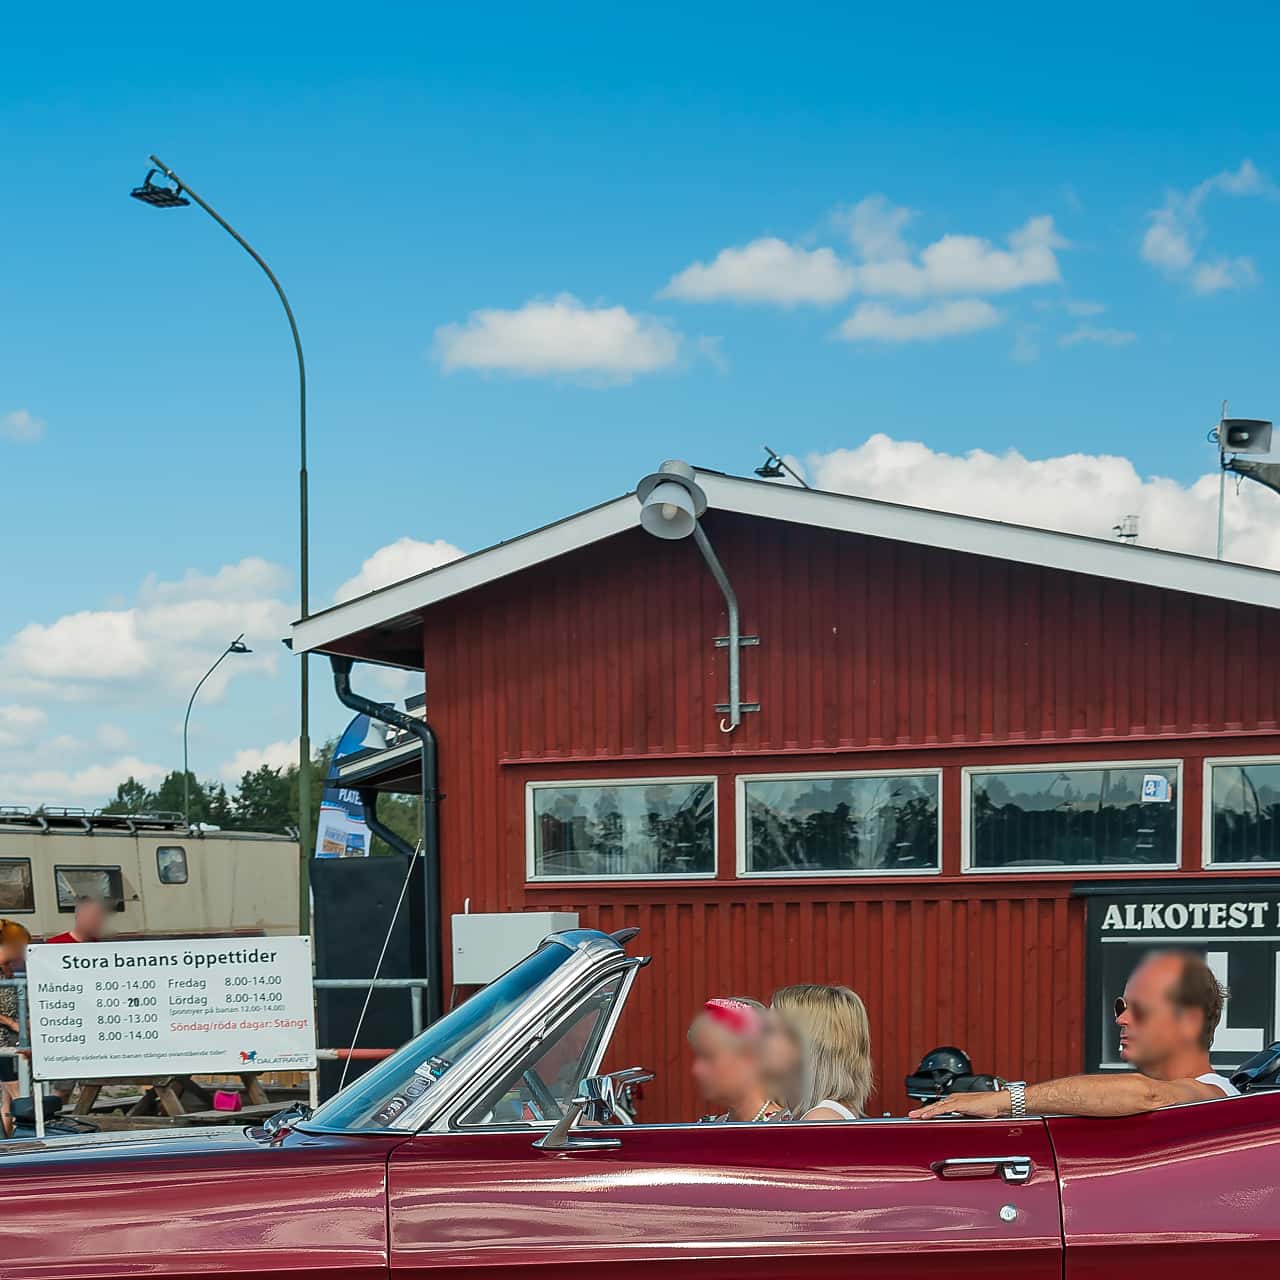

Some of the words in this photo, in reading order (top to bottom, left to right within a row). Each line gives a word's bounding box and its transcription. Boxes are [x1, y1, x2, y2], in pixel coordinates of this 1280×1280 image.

[1101, 901, 1269, 931] ALKOTEST
[62, 954, 109, 969] Stora
[114, 953, 178, 968] banans
[183, 949, 277, 968] öppettider
[38, 982, 83, 994] Måndag
[95, 981, 119, 990] 8.00
[168, 978, 206, 989] Fredag
[224, 975, 282, 986] 8.00-14.00
[39, 1000, 75, 1011] Tisdag
[96, 998, 120, 1008] 8.00
[169, 994, 208, 1006] Lördag
[225, 992, 282, 1003] 8.00-14.00
[40, 1016, 83, 1027] Onsdag
[97, 1015, 121, 1024] 8.00
[239, 1020, 272, 1031] dagar:
[274, 1018, 308, 1030] Stängt
[40, 1033, 86, 1044] Torsdag
[98, 1031, 122, 1040] 8.00
